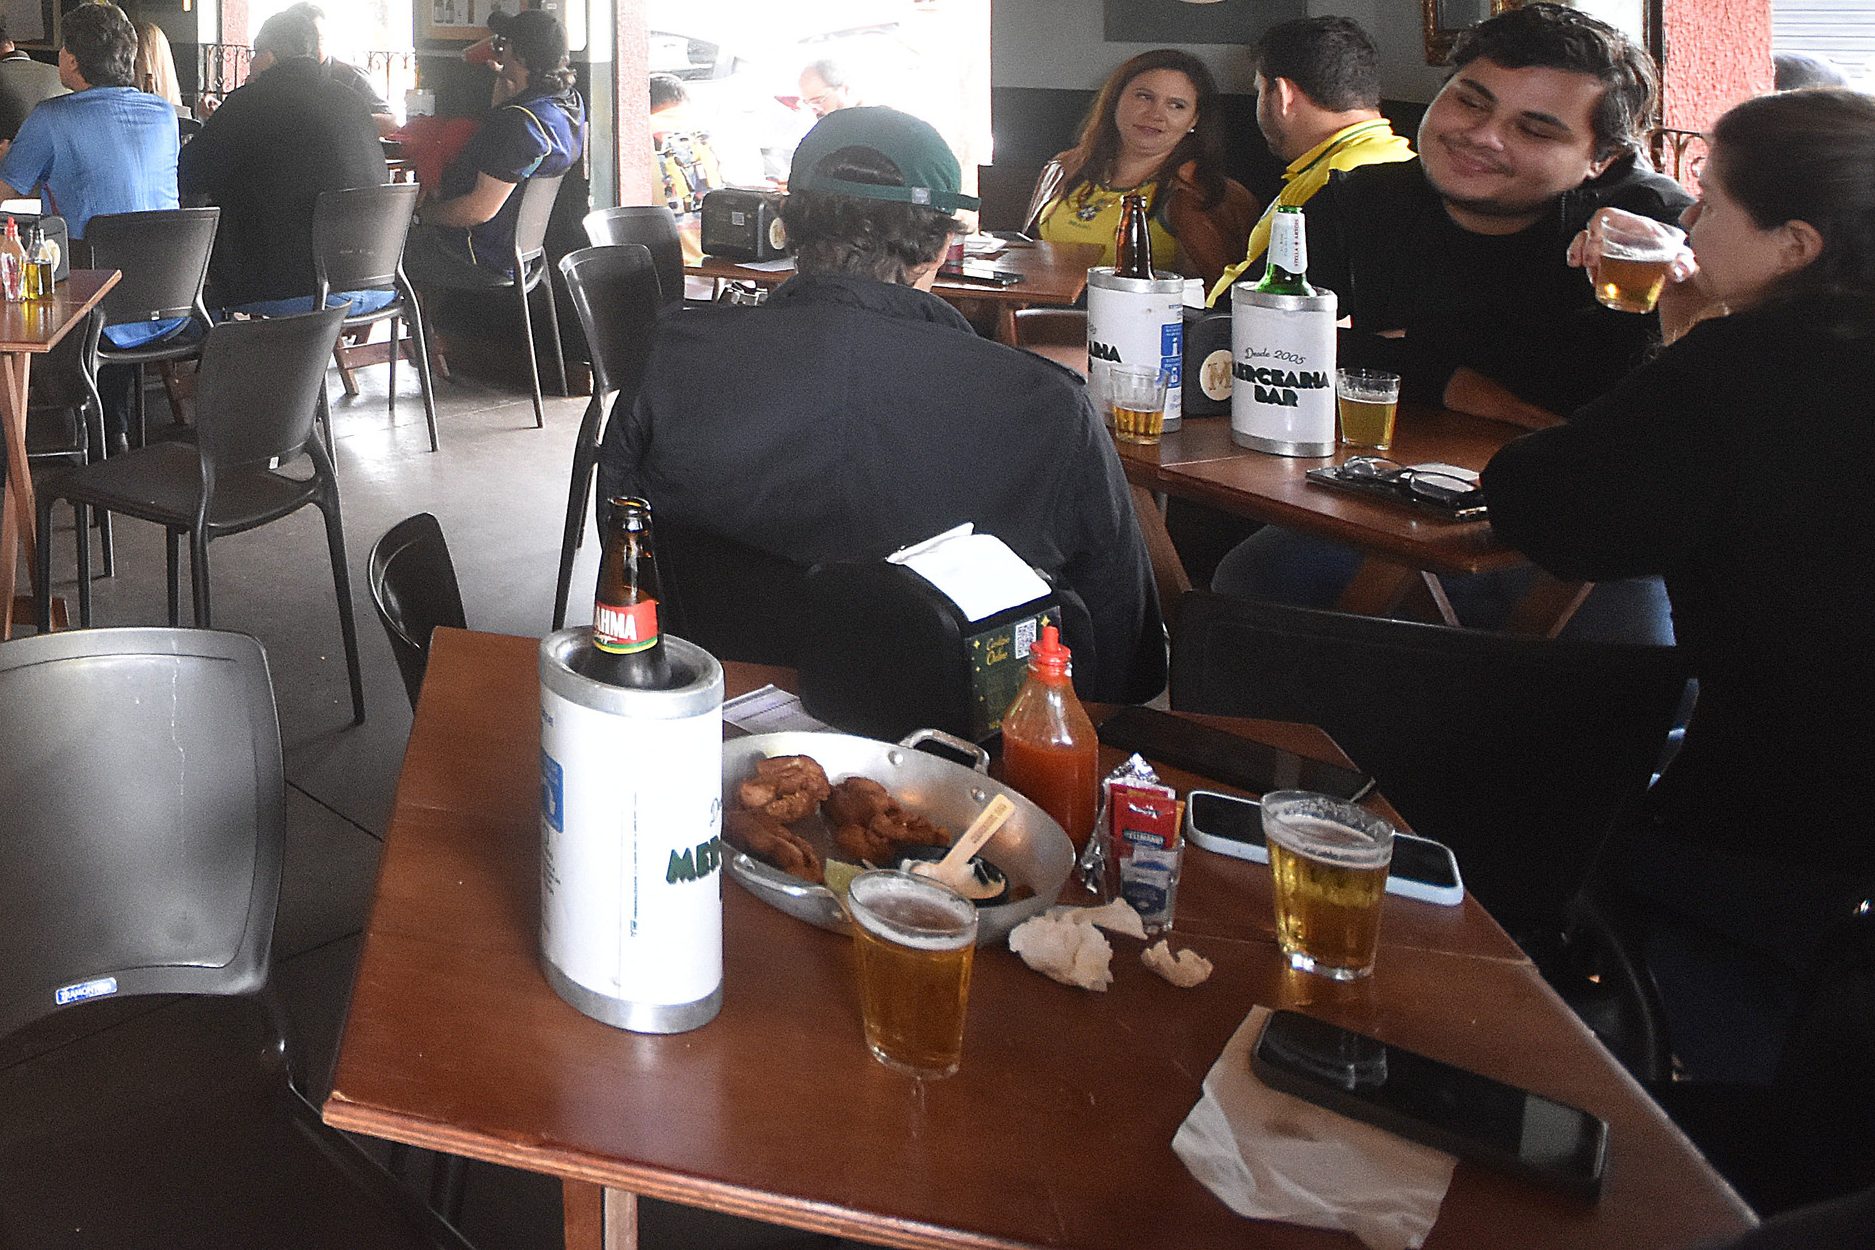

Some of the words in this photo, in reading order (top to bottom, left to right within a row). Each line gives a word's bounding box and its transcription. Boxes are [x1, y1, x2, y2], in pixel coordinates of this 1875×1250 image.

[1245, 347, 1271, 359] Desde
[1274, 350, 1306, 364] 2005
[1254, 384, 1298, 408] BAR
